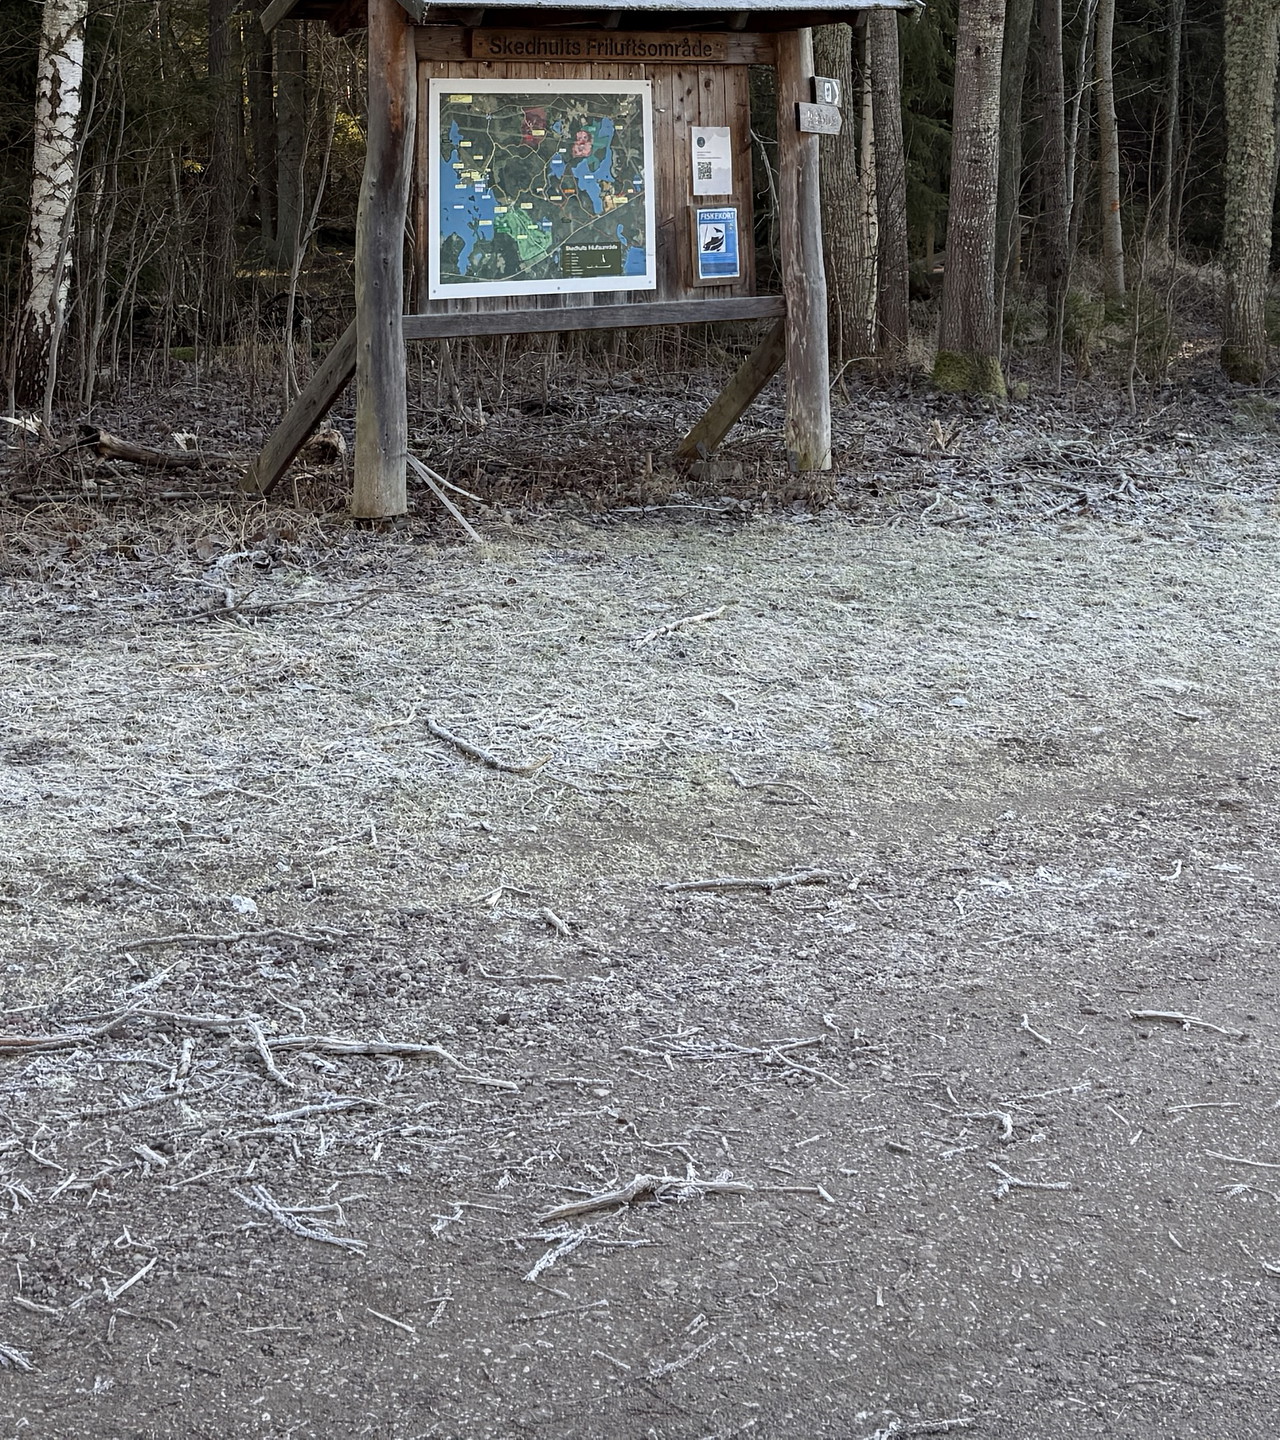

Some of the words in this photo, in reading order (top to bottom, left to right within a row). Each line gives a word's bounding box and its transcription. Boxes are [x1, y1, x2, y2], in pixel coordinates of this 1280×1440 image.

[489, 36, 581, 55] Skedhults
[586, 37, 714, 58] Friluftsområde
[700, 212, 735, 220] FISKEKORT
